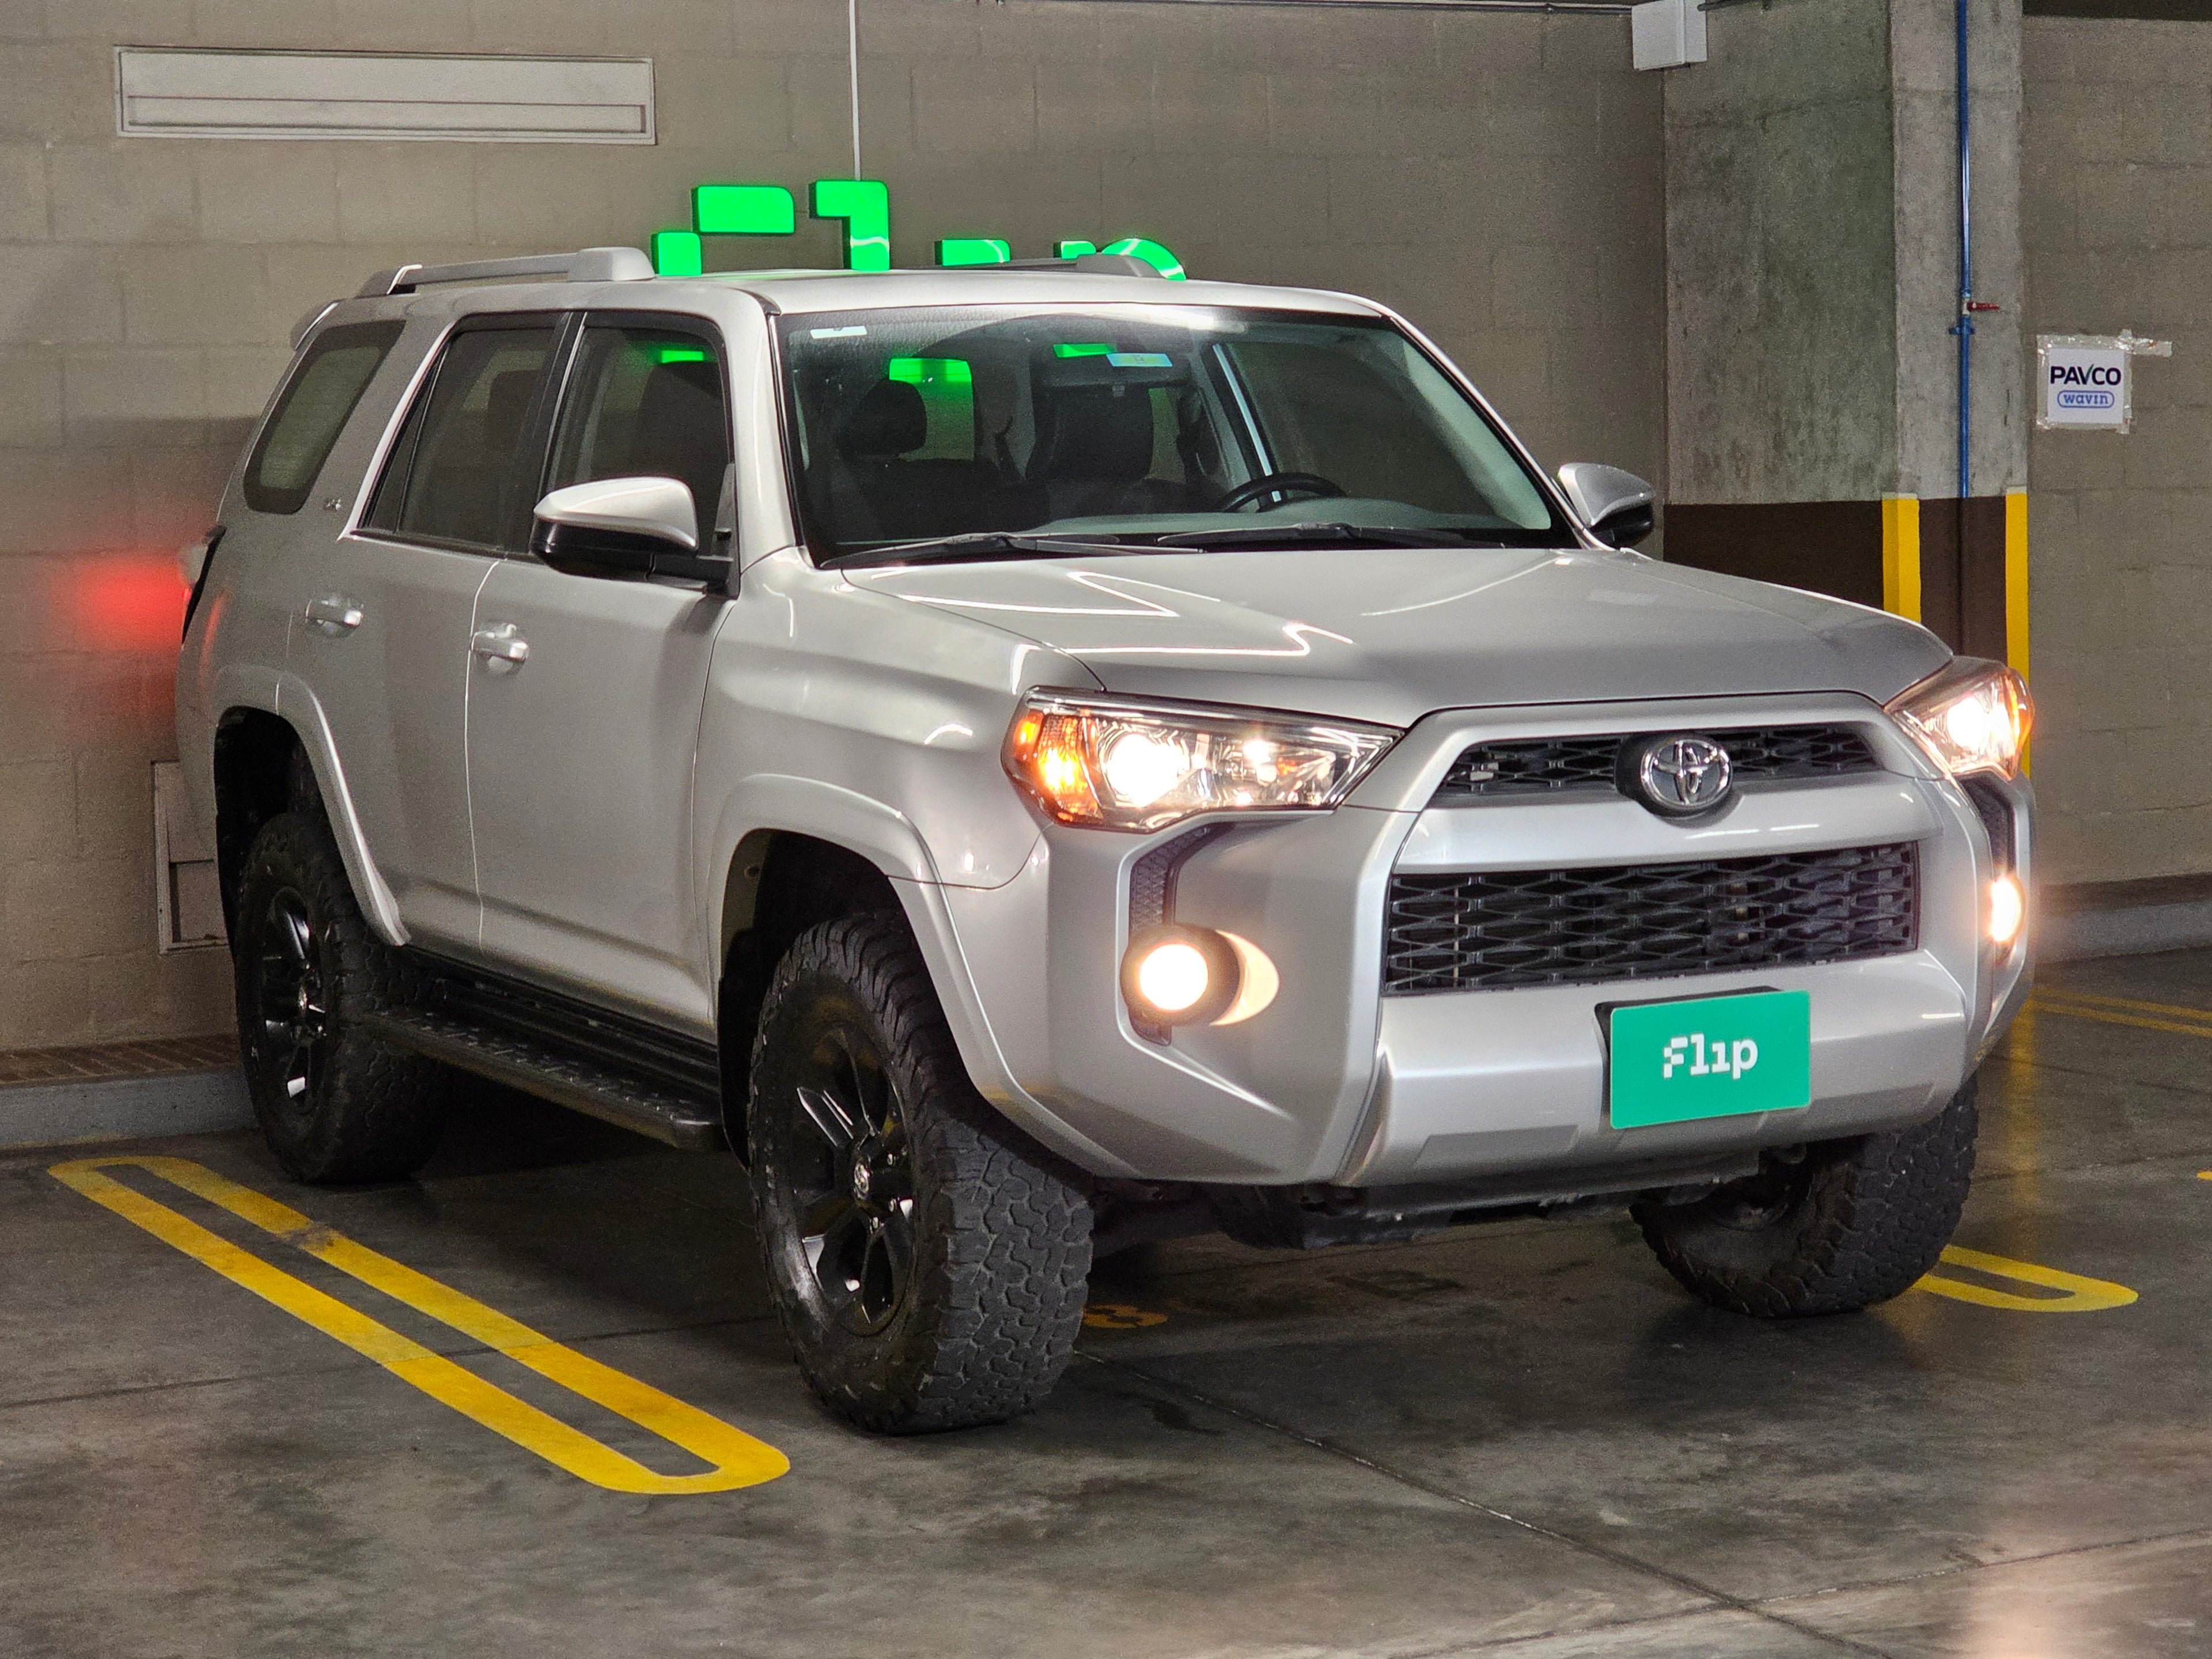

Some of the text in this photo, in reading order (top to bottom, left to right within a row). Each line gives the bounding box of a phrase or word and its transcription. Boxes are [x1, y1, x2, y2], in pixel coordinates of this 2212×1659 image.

[2050, 363, 2122, 385] PAVCO
[2063, 393, 2109, 405] wavin
[1663, 1033, 1759, 1080] Flip
